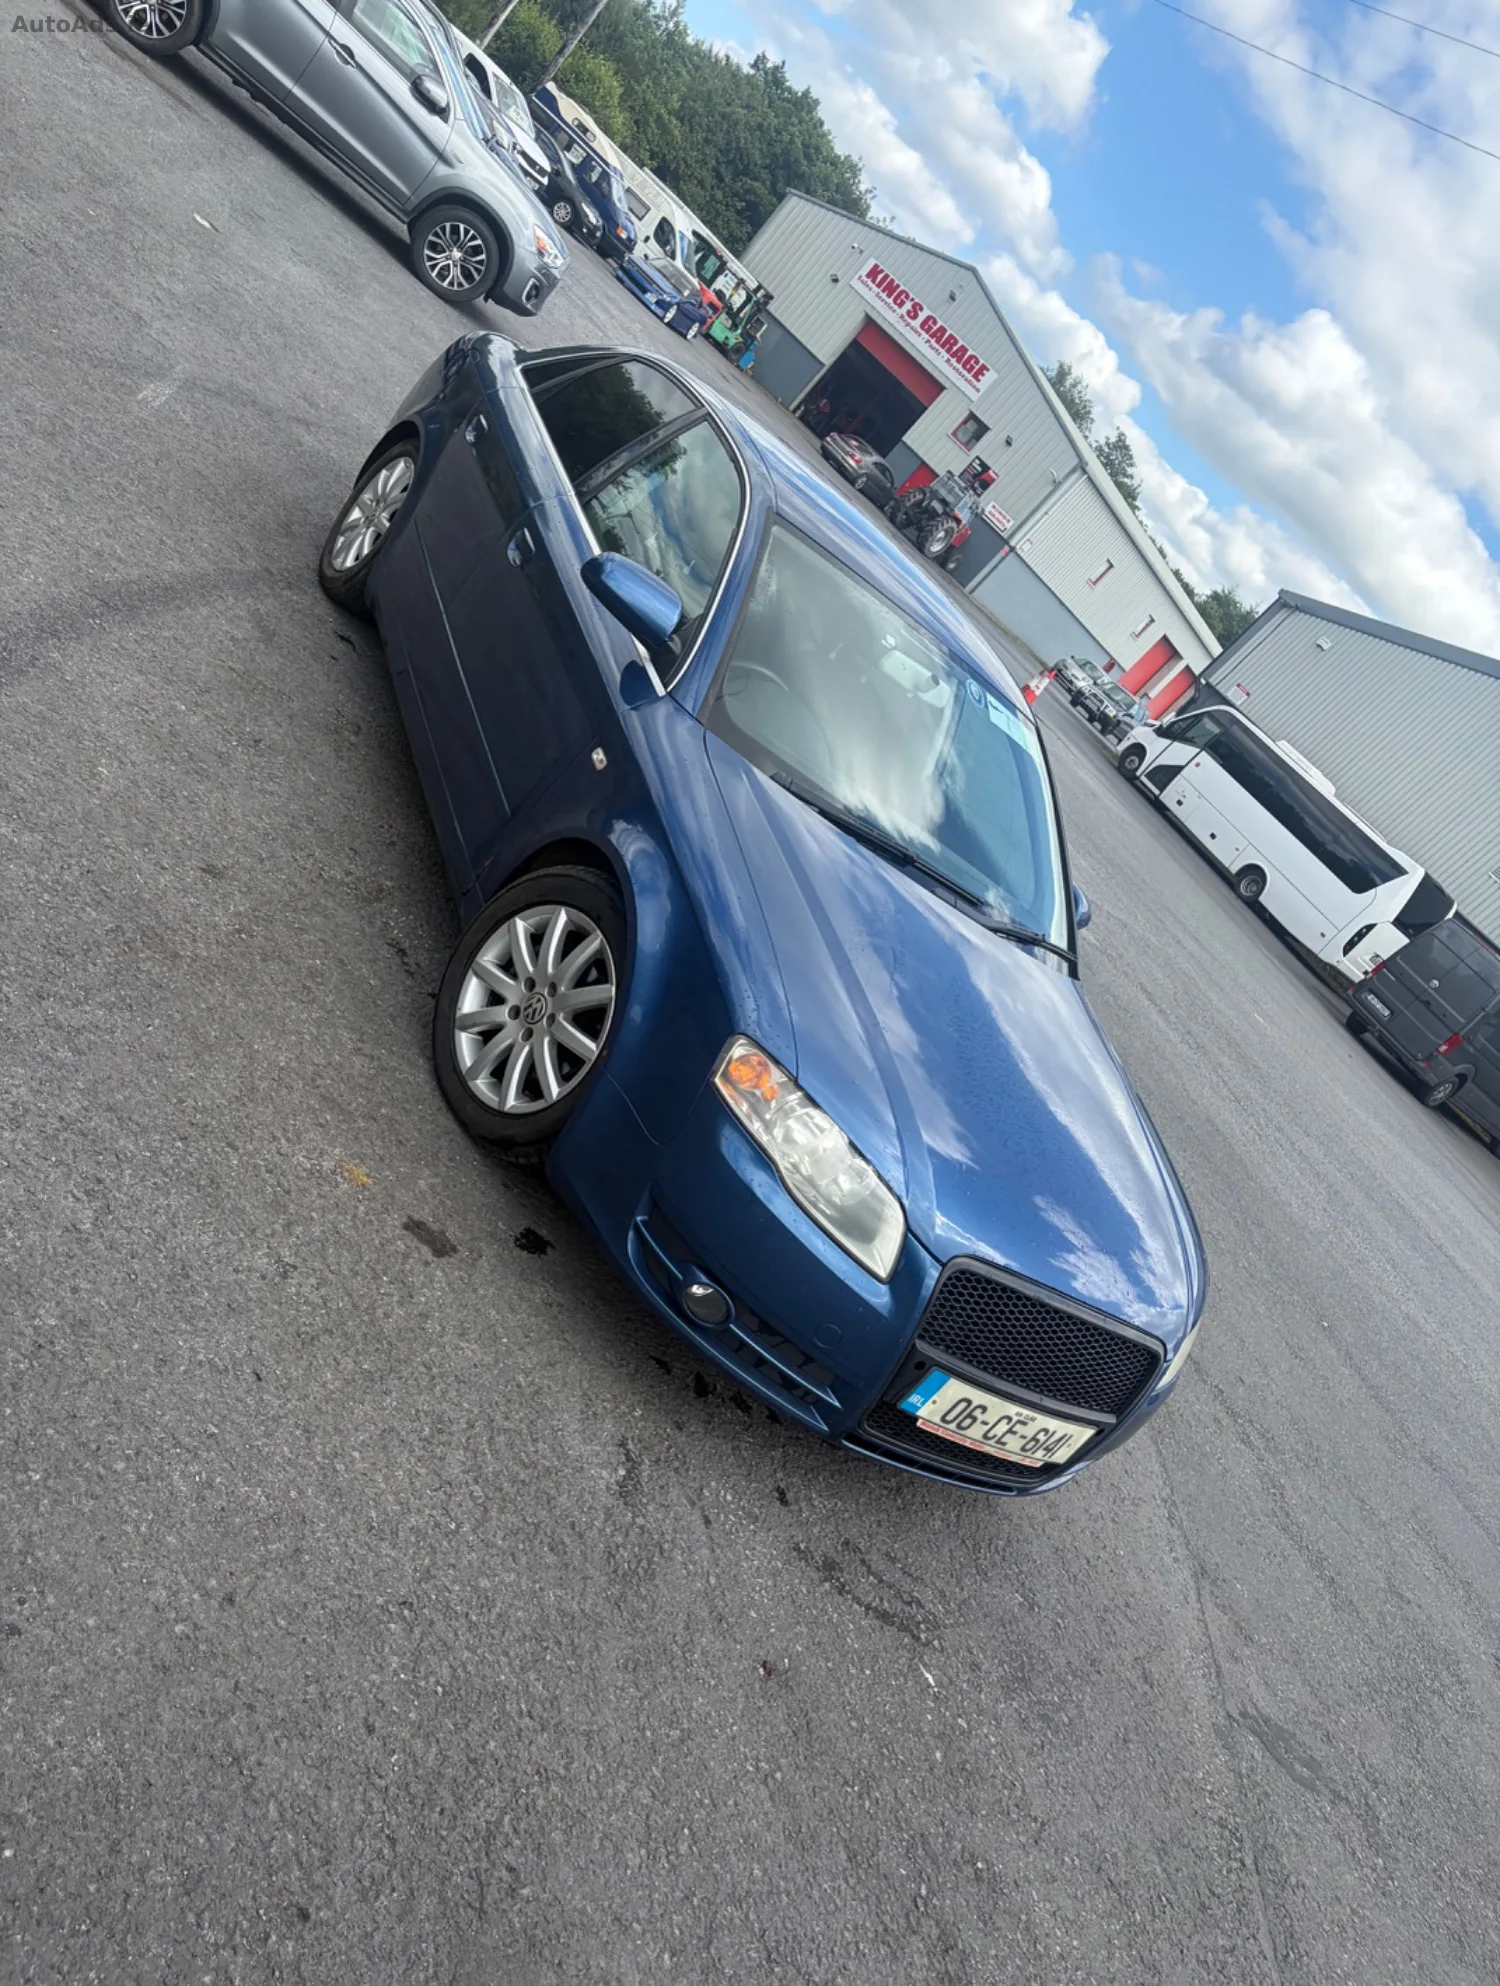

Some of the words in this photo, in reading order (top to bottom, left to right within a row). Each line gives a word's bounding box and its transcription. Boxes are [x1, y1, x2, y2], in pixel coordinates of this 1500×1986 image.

[864, 263, 924, 320] KING'S
[919, 315, 990, 383] GARAGE
[924, 339, 942, 356] Parts
[908, 1394, 925, 1408] IRL
[940, 1397, 1073, 1459] 06-CE-6141
